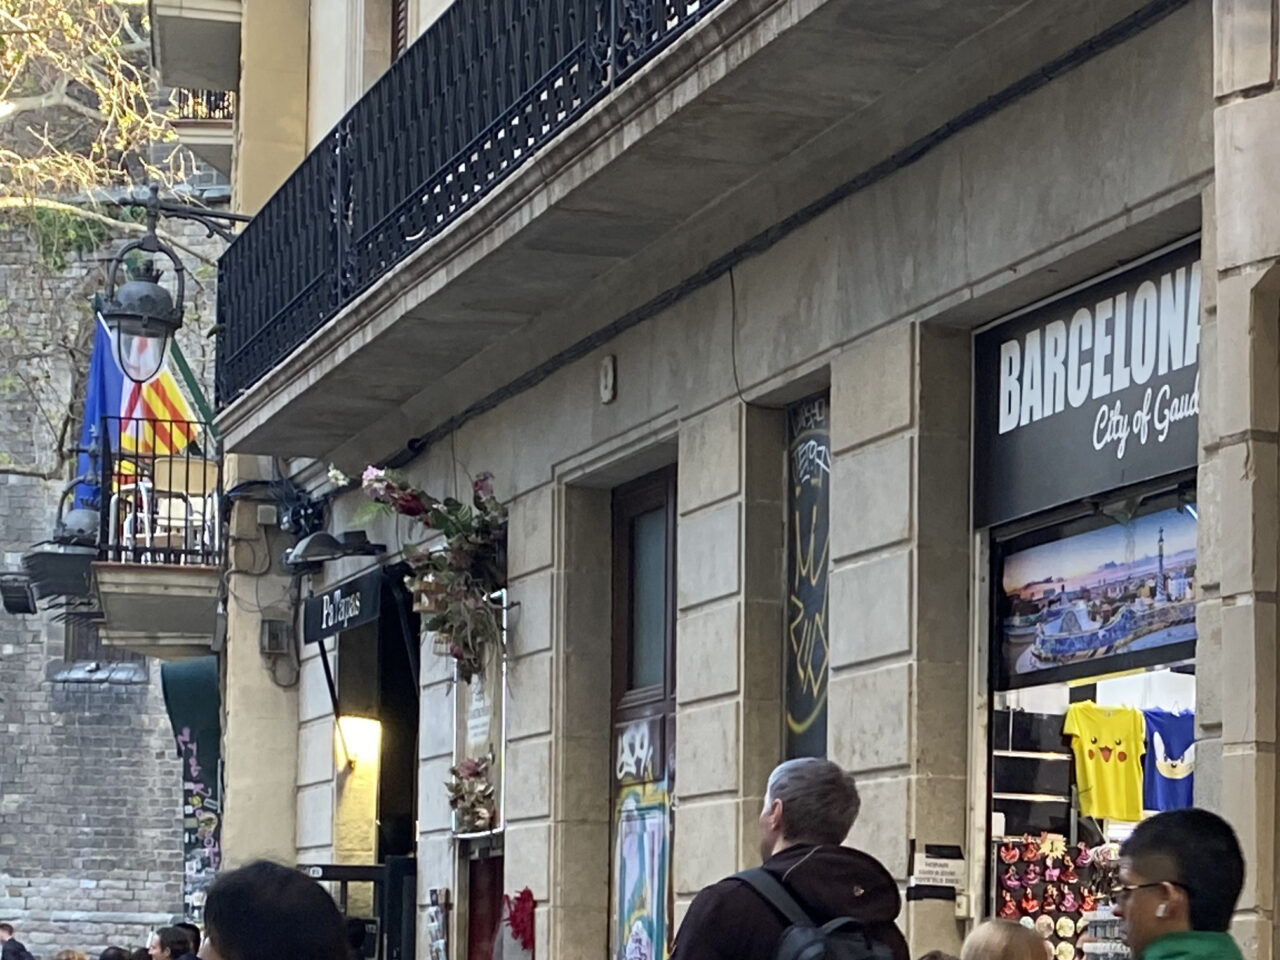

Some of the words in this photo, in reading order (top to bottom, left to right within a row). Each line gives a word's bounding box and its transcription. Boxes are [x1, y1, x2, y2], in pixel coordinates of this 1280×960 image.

[999, 259, 1201, 435] BARCELONA
[1093, 400, 1130, 459] City
[1133, 387, 1153, 445] of
[1153, 369, 1200, 442] Gaud
